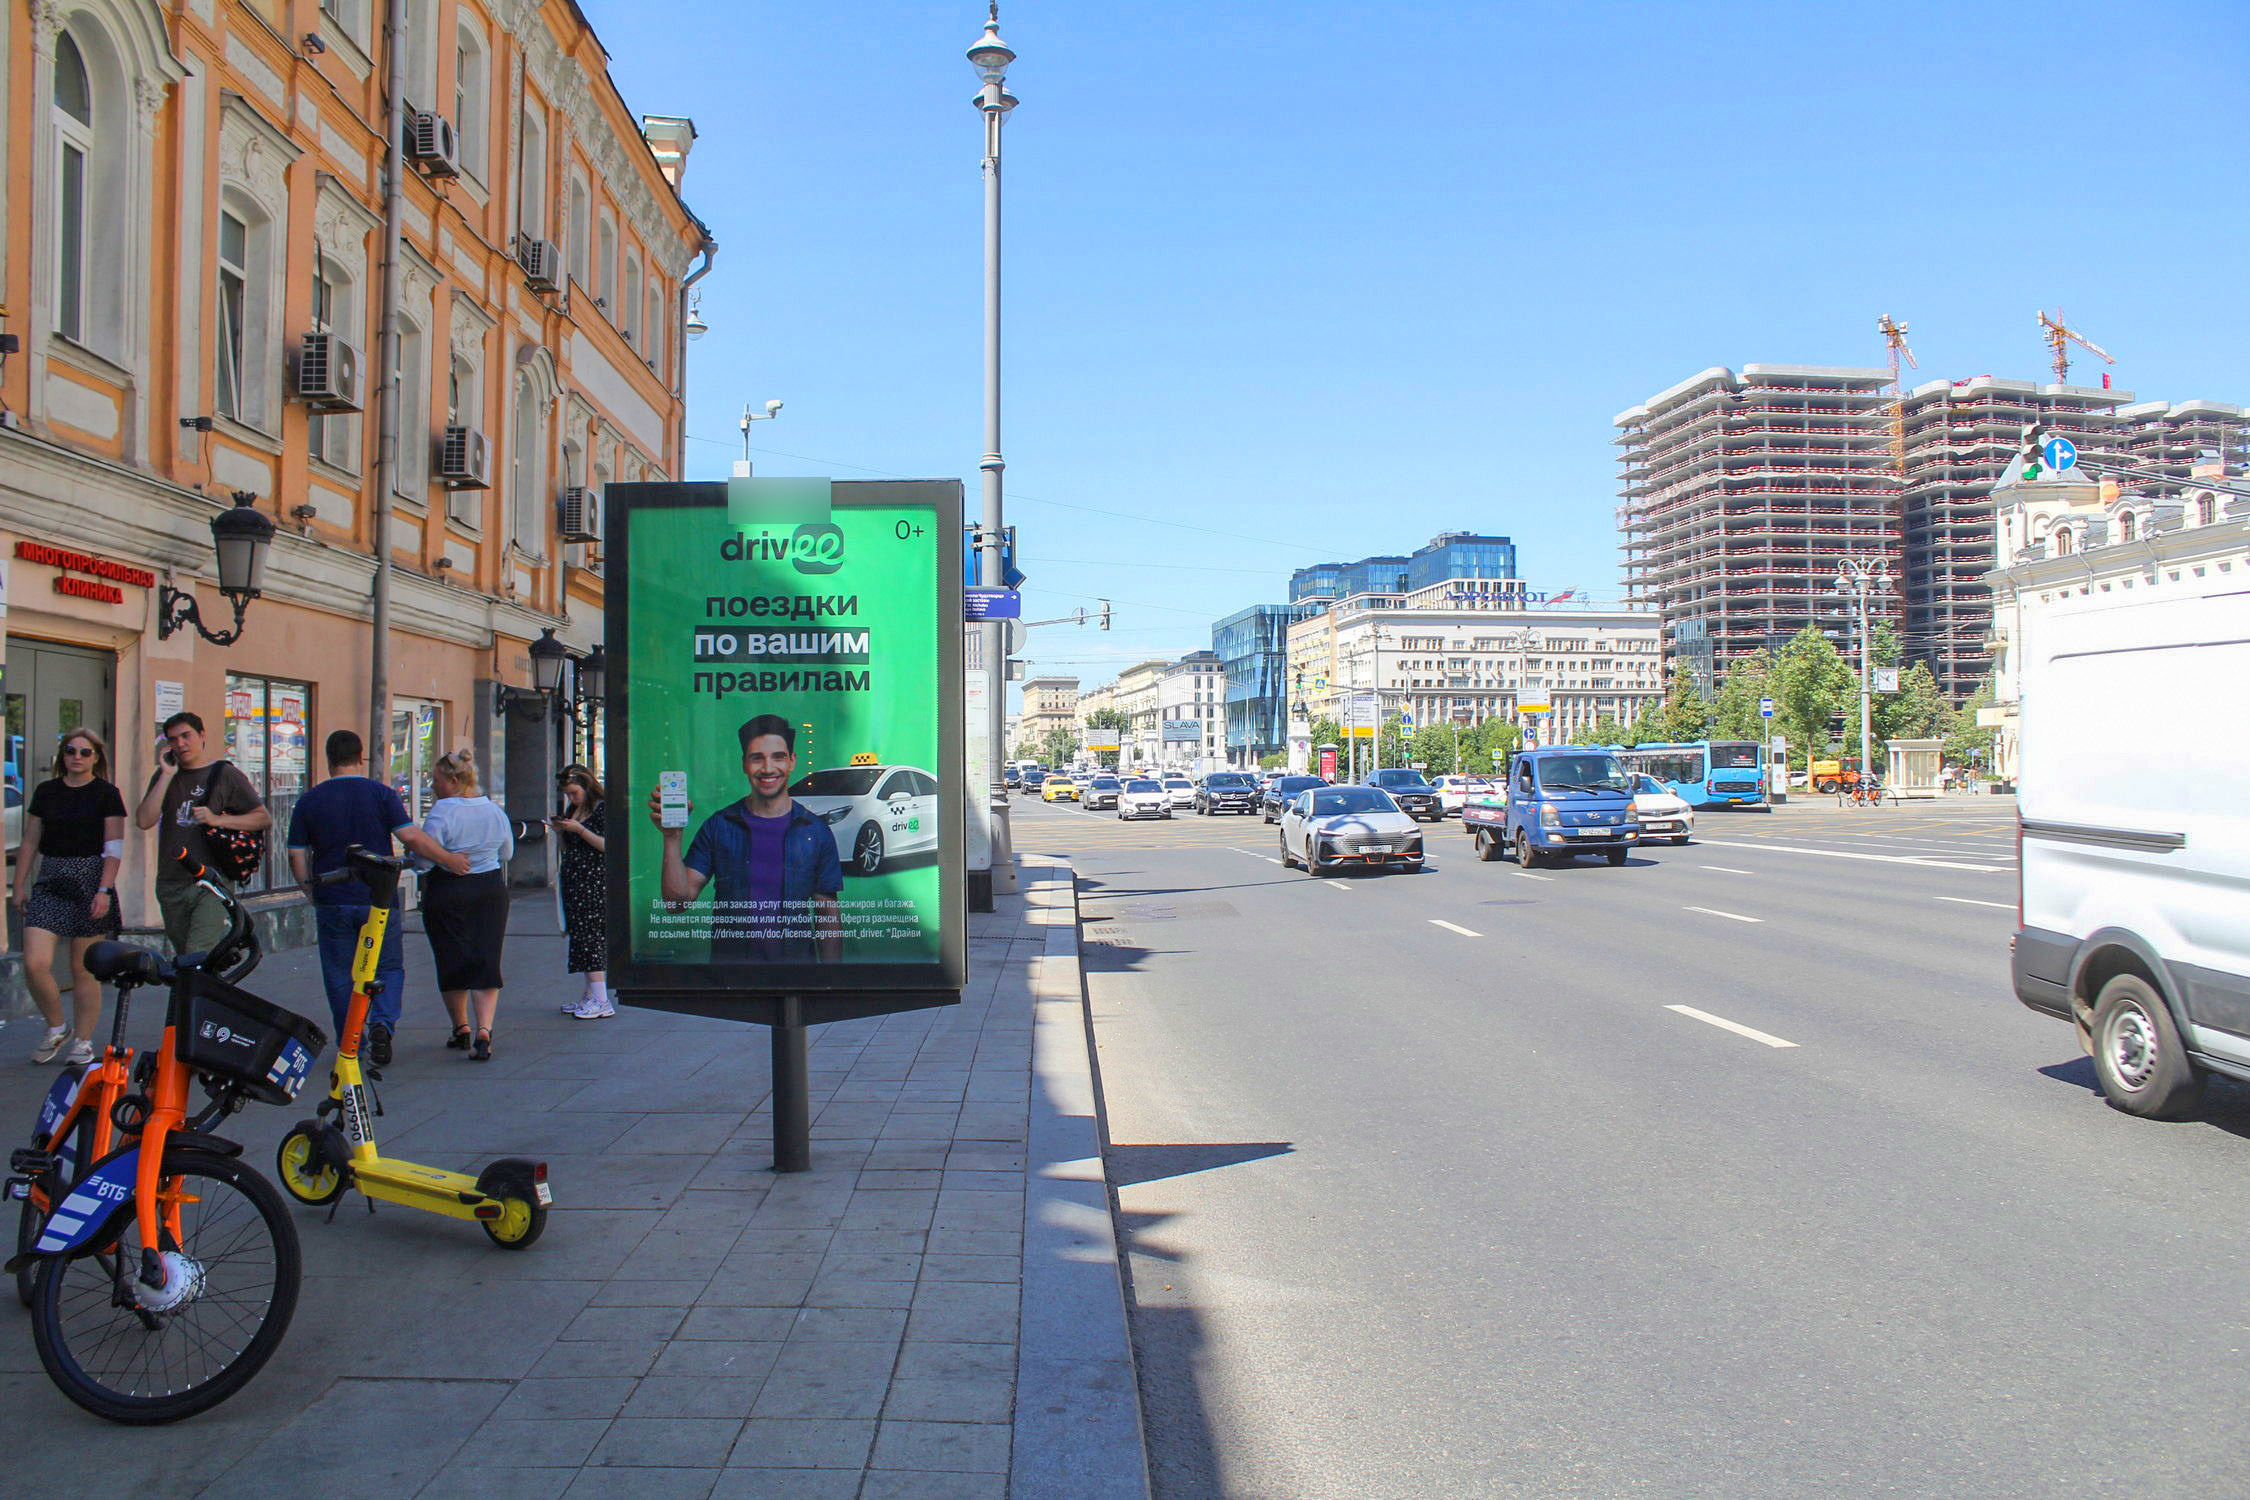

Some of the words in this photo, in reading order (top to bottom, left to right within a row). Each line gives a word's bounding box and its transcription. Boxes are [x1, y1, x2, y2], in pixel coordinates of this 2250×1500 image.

[895, 519, 925, 540] 0+
[720, 528, 845, 568] drivee
[22, 542, 155, 588] МНОГОПРОФИЛЬНАЯ
[62, 576, 123, 604] КЛИНИКА
[706, 595, 858, 621] поездки
[695, 633, 738, 656] по
[748, 632, 869, 655] вашим
[694, 670, 870, 700] правилам
[1163, 720, 1200, 729] SLAVA
[652, 898, 677, 909] Drivee
[682, 901, 712, 911] сервис
[712, 901, 728, 911] для
[729, 901, 757, 909] заказа
[757, 901, 782, 911] услуг
[782, 900, 825, 910] перевозки
[826, 900, 876, 910] пассажиров
[877, 900, 883, 908] и
[884, 898, 916, 908] багажа.
[650, 913, 661, 924] Не
[661, 915, 700, 924] является
[700, 915, 758, 926] перевозчиком
[759, 915, 776, 923] или
[776, 913, 813, 925] службой
[813, 915, 839, 924] такси.
[840, 912, 871, 925] Оферта
[871, 914, 919, 924] размещена
[648, 929, 659, 939] по
[659, 929, 691, 939] ссылке
[293, 1053, 309, 1074] ВТБ
[342, 1088, 362, 1143] 307990
[97, 1180, 128, 1201] ВТБ
